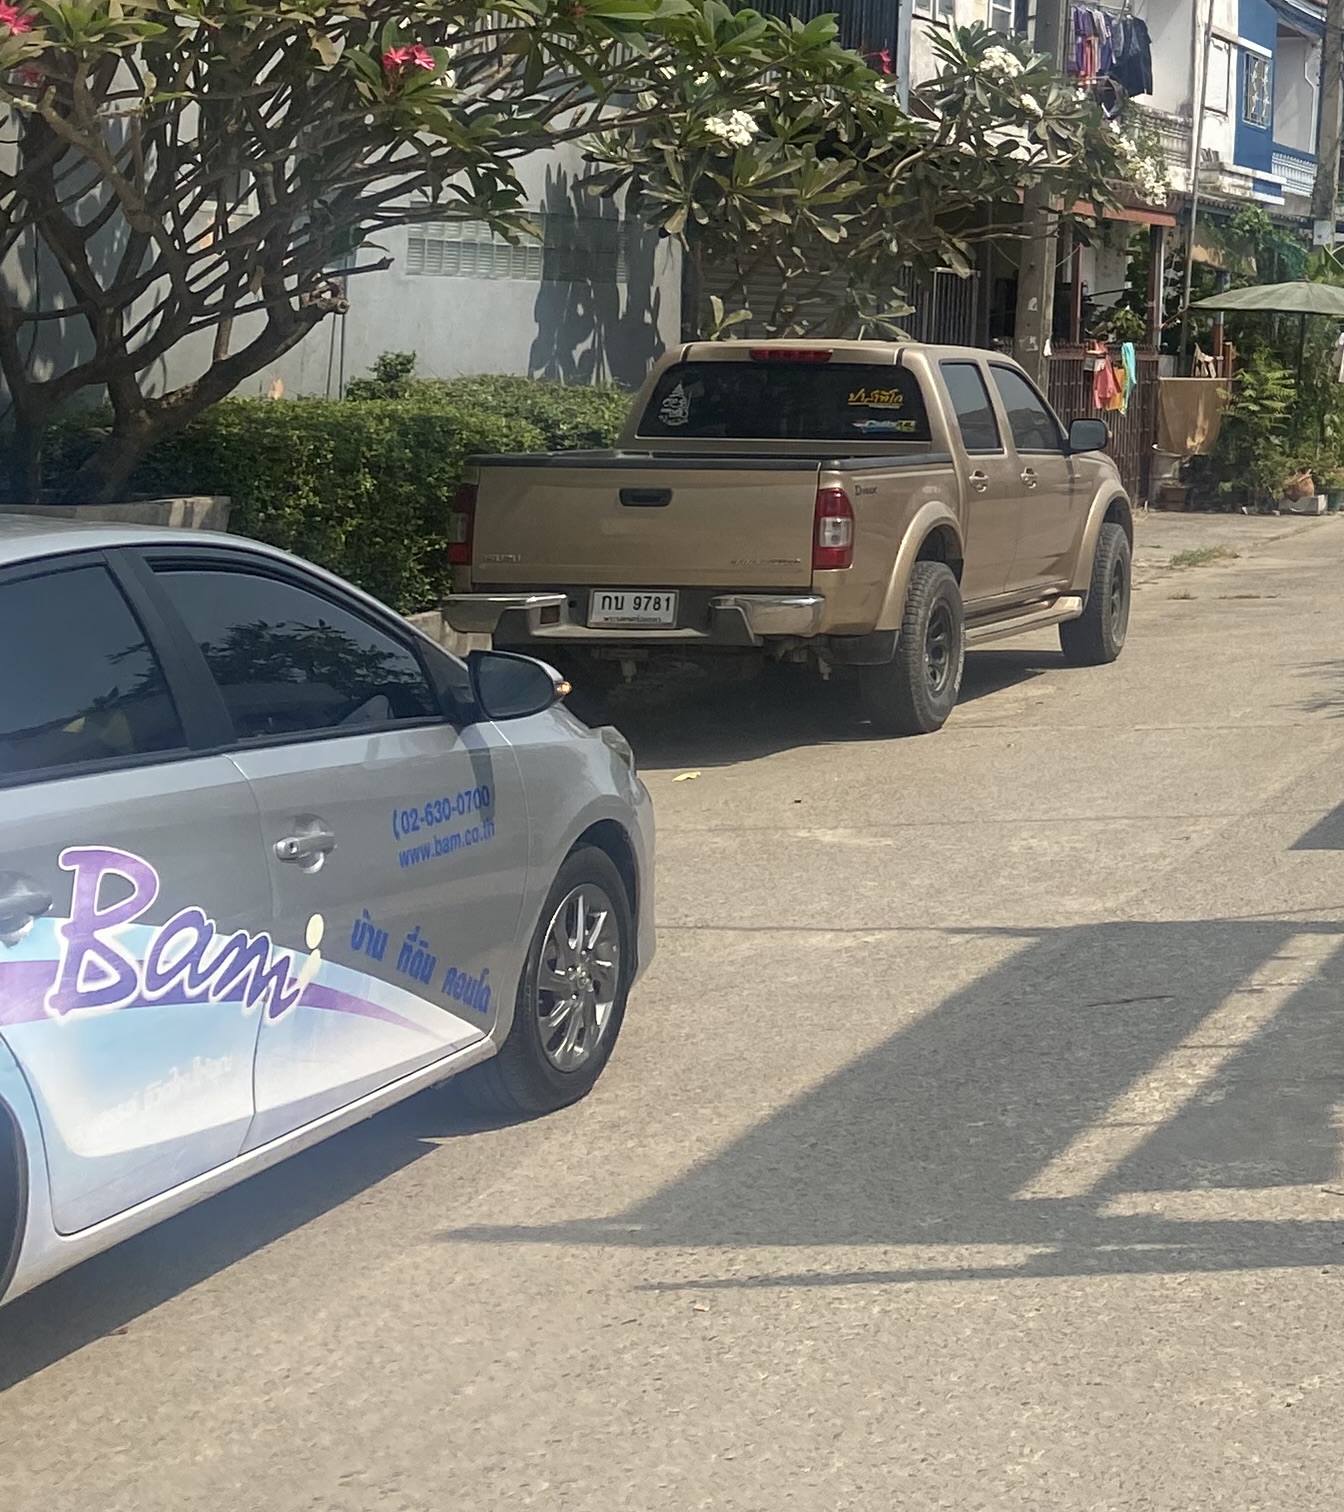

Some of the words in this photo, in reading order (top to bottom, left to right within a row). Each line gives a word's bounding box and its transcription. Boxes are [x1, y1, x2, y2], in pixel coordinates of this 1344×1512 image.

[632, 595, 671, 612] 9781
[399, 817, 495, 868] www.bam.co.th
[351, 908, 389, 962] บ้าน
